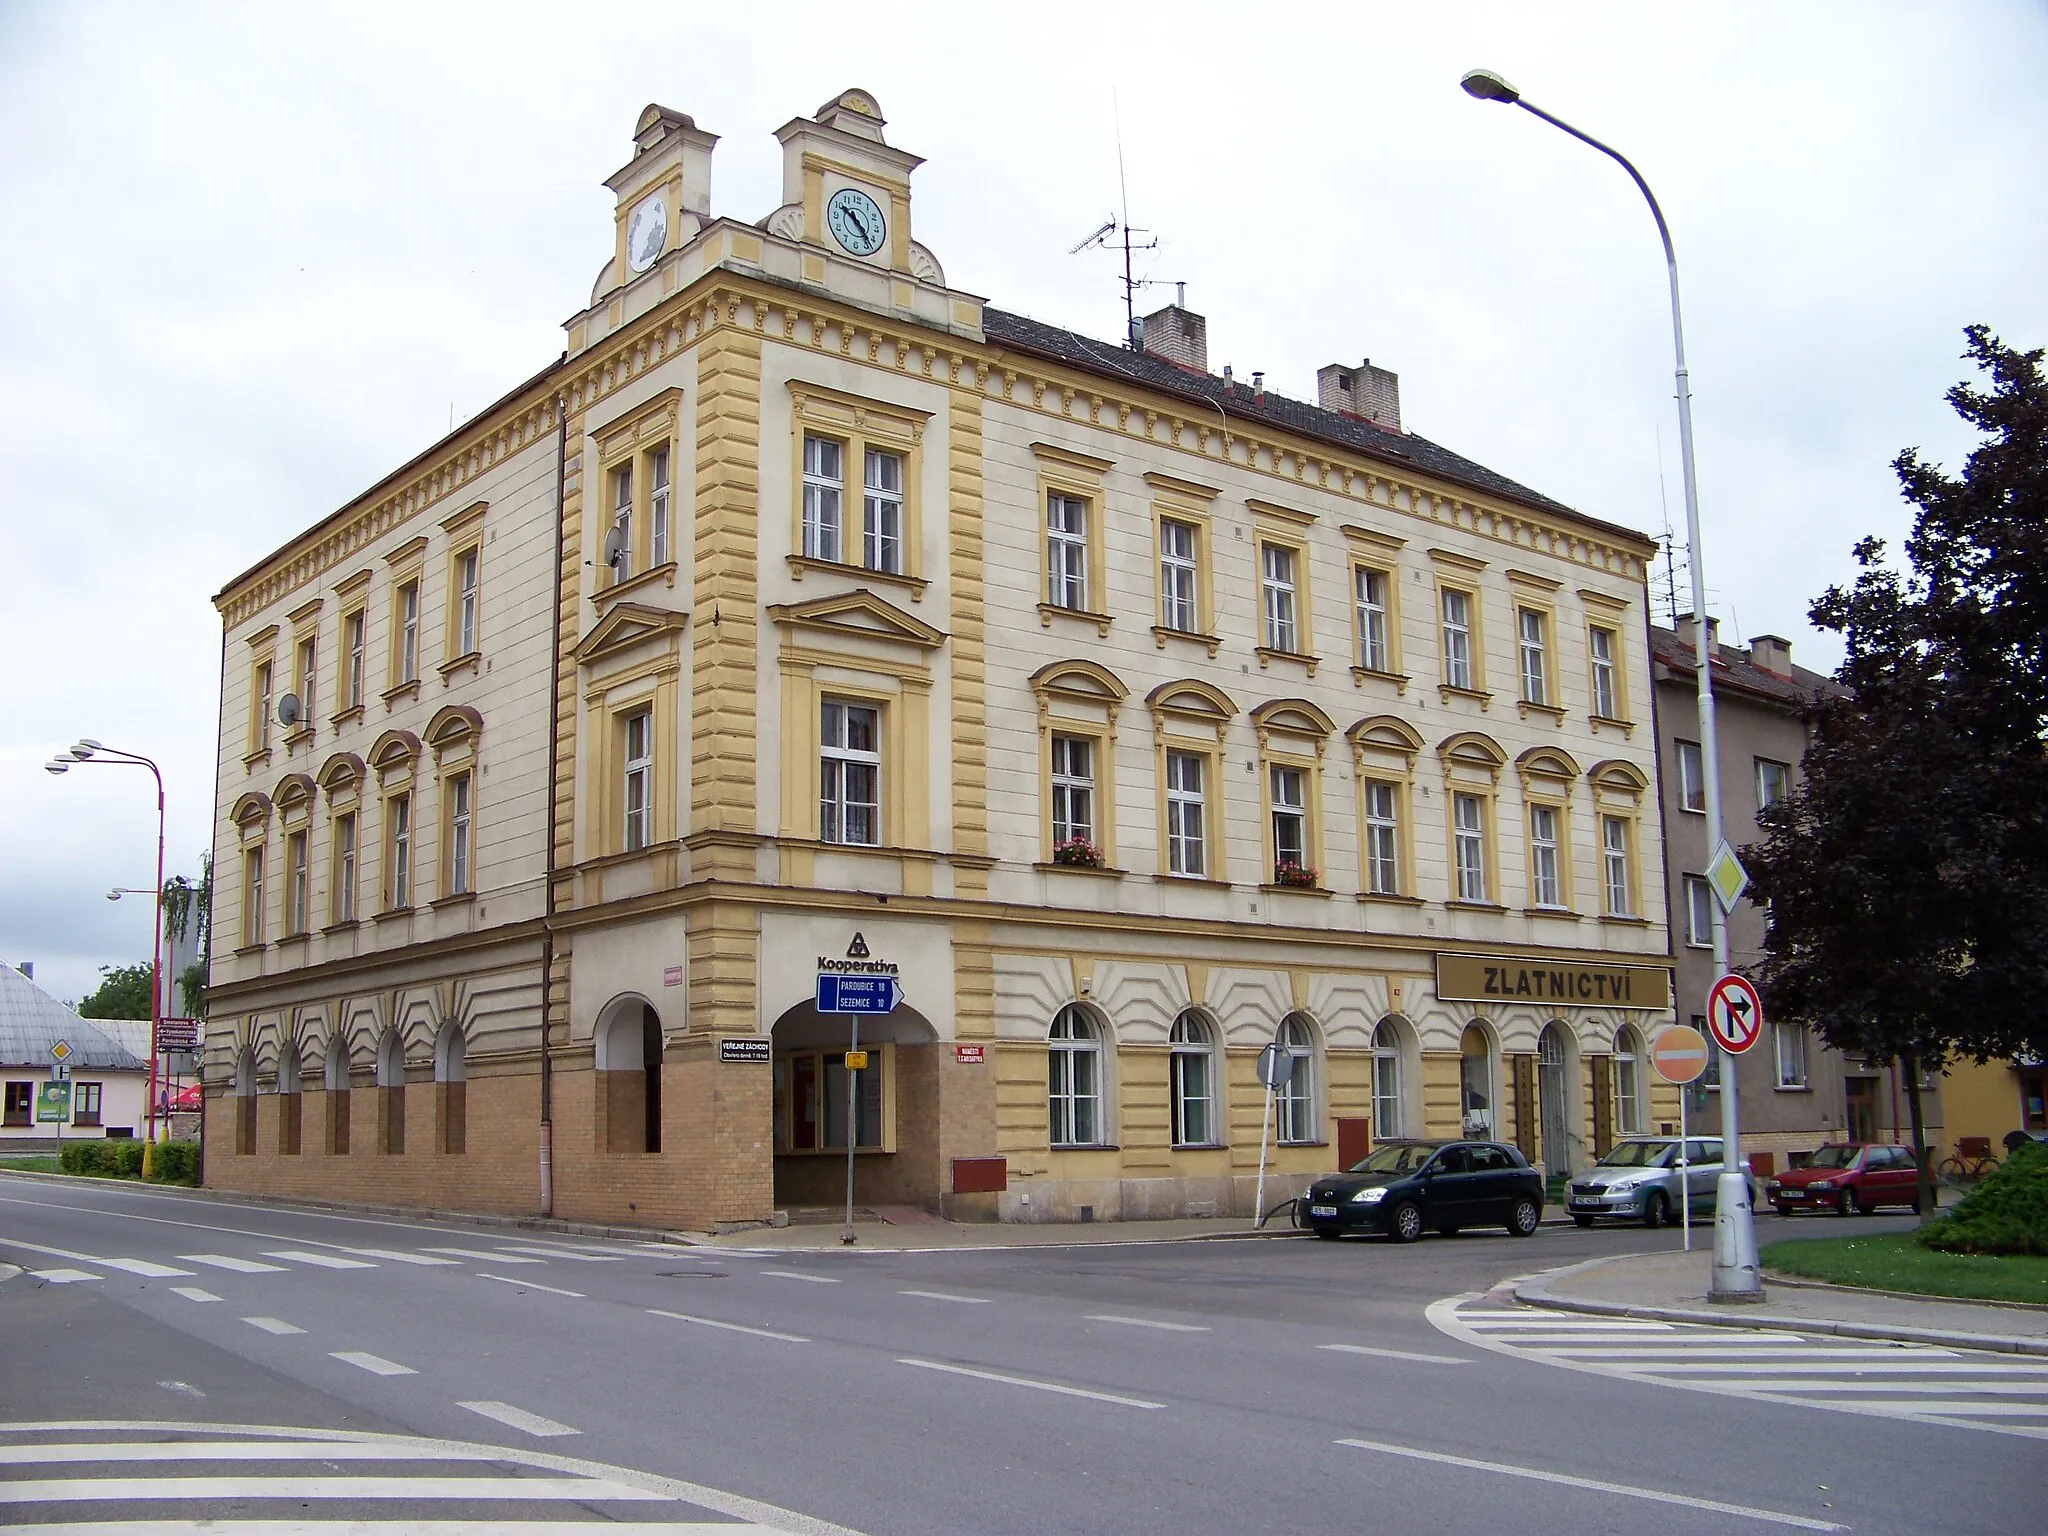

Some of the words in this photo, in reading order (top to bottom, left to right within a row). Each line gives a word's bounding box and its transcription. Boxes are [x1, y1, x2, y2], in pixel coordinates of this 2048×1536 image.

[844, 196, 851, 204] 11
[853, 196, 862, 205] 12
[835, 201, 844, 209] 10
[833, 211, 839, 219] 9
[872, 213, 877, 221] 2
[836, 223, 841, 232] 8
[874, 225, 880, 233] 3
[843, 235, 848, 243] 7
[853, 241, 859, 249] 6
[817, 956, 899, 974] Kooperativa
[841, 981, 874, 991] PARDUBICE
[1484, 967, 1631, 1000] ZLATNICTVÍ
[840, 997, 870, 1007] SEZEMICE
[723, 1041, 745, 1050] VEŘEJNÉ
[745, 1042, 769, 1051] ZÁCHODY
